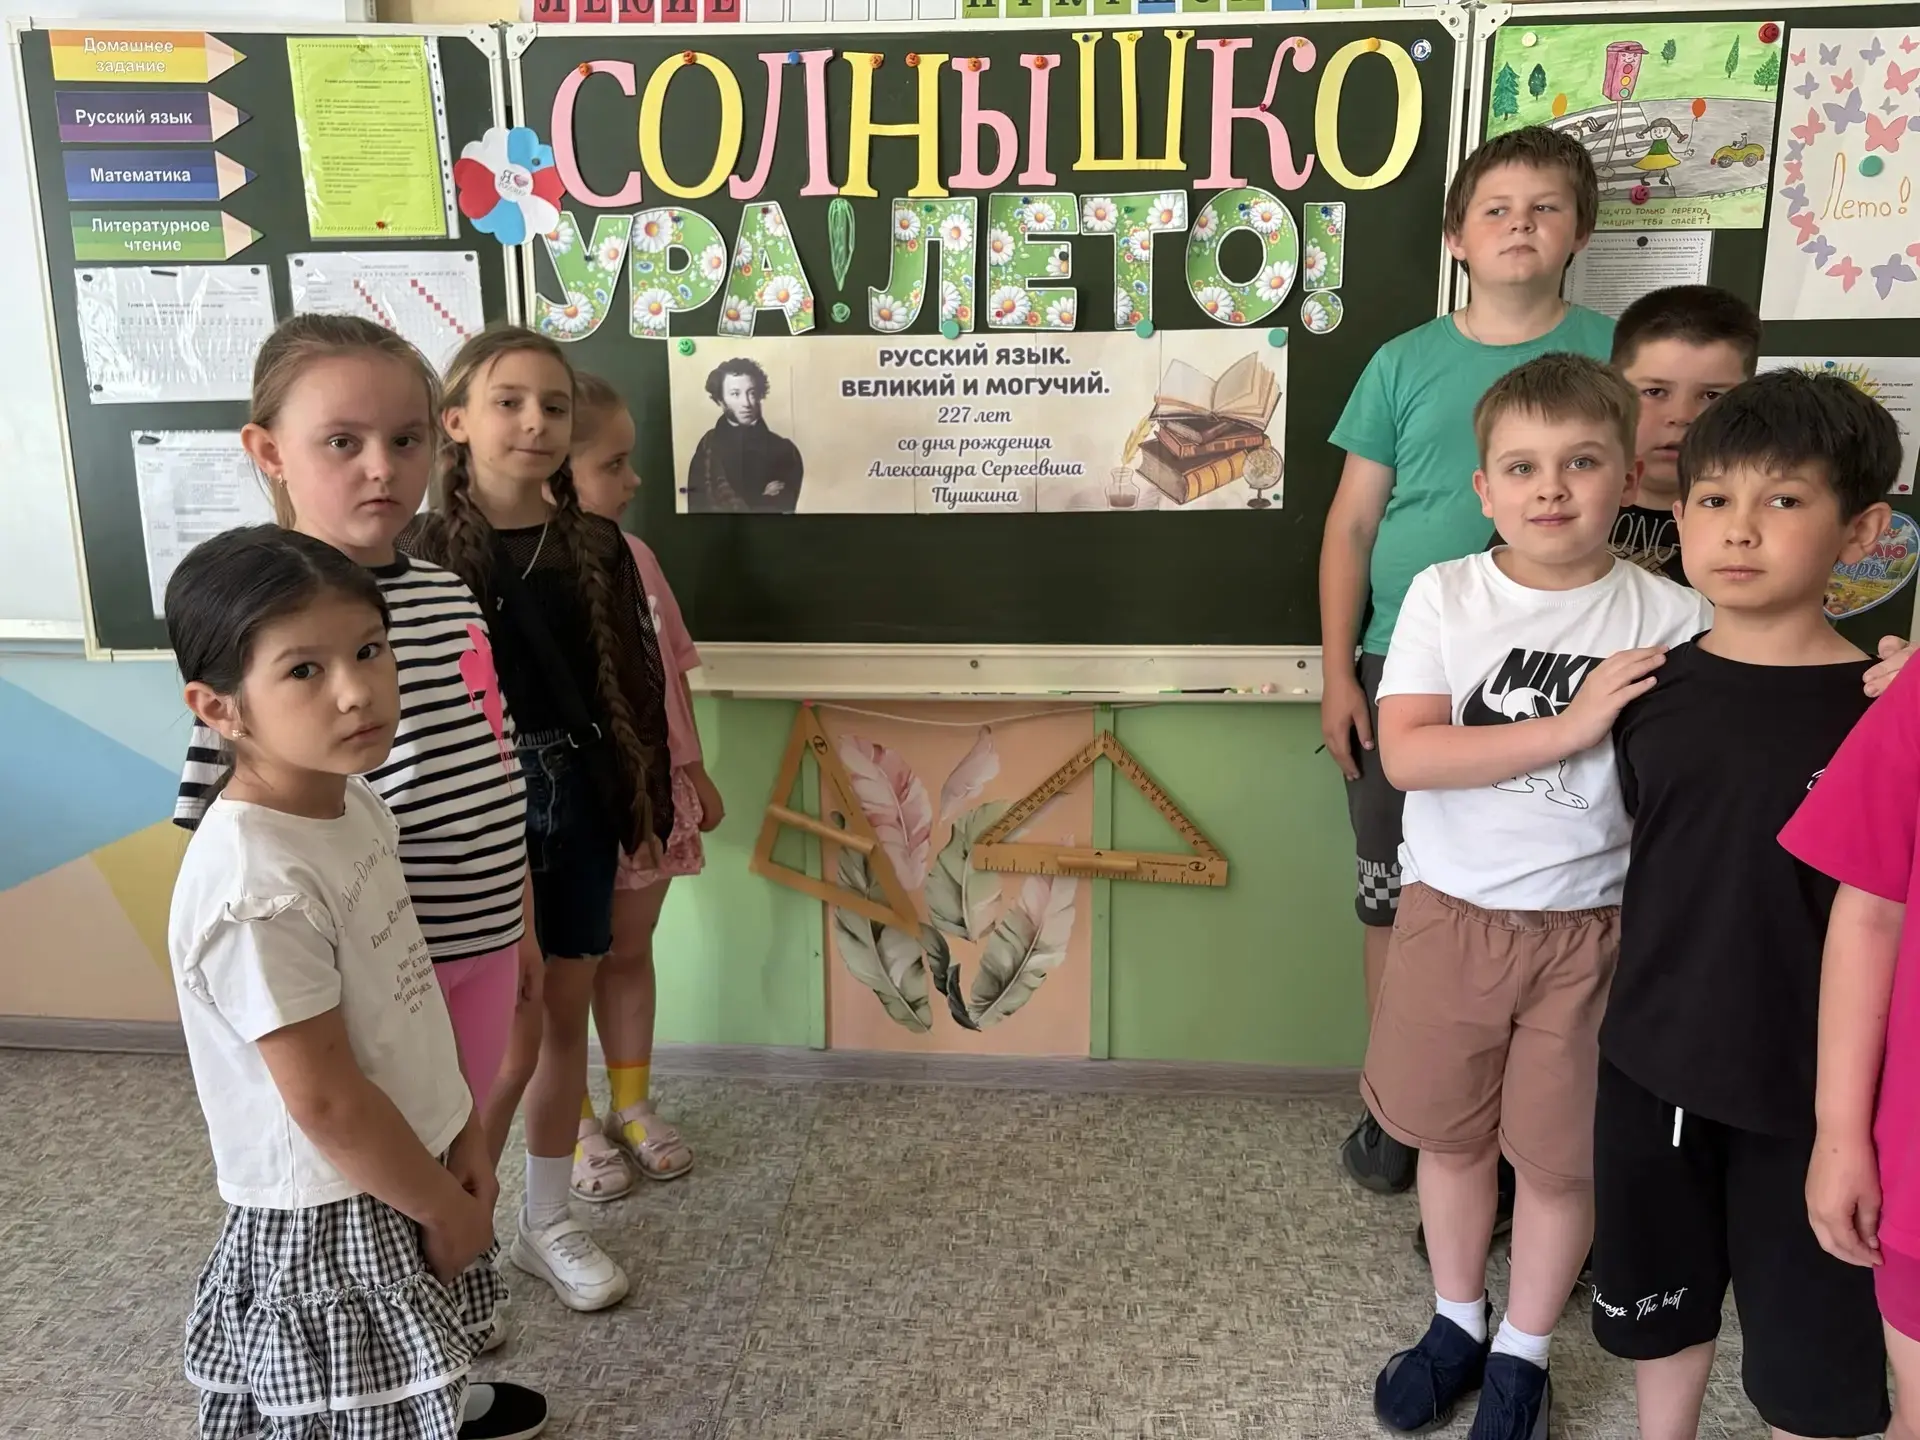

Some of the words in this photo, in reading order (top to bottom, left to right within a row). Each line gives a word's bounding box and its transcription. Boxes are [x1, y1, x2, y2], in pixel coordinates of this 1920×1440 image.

[84, 37, 174, 55] Домашнее
[96, 61, 165, 73] задание
[75, 109, 145, 127] Русский
[150, 112, 192, 124] язык
[551, 29, 1422, 207] СОЛНЫШКО
[90, 167, 191, 182] Математика
[91, 218, 210, 236] Литературное
[124, 240, 182, 251] чтение
[534, 197, 856, 342] УРА!
[868, 186, 1347, 335] ЛЕТО!
[879, 342, 988, 367] РУССКИЙ
[995, 346, 1071, 366] ЯЗЫК.
[841, 373, 955, 397] ВЕЛИКИЙ
[963, 378, 979, 396] И
[986, 370, 1110, 396] МОГУЧИЙ.
[937, 406, 972, 424] 227
[973, 410, 1012, 423] лет
[898, 438, 919, 451] со
[922, 438, 956, 457] дня
[958, 436, 1053, 457] рождения
[867, 460, 977, 484] Александра
[981, 457, 1085, 483] Сергеевича
[931, 486, 1020, 510] Пушкина
[1489, 647, 1607, 704] NIK
[1635, 1293, 1659, 1321] The
